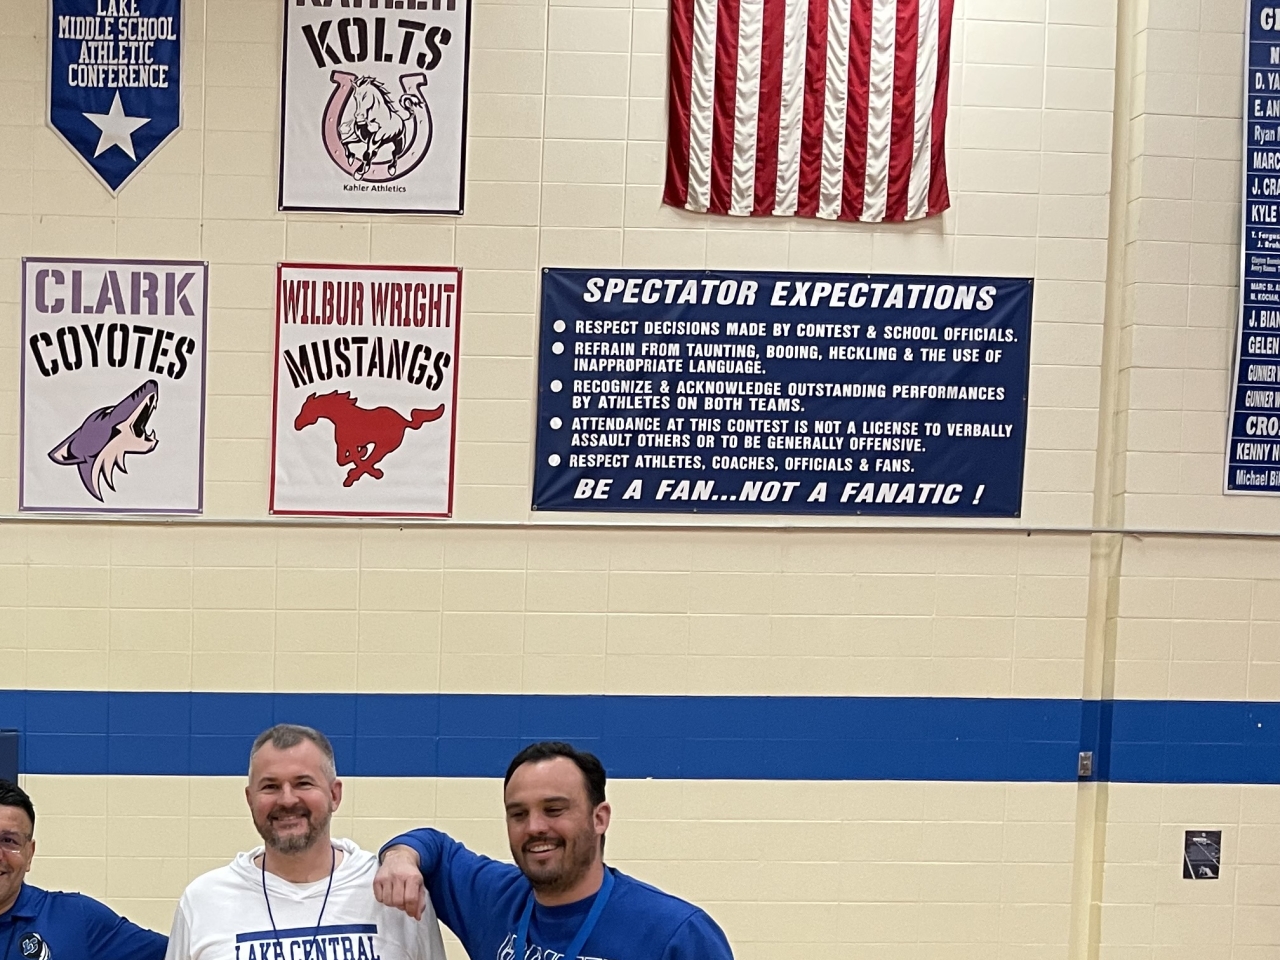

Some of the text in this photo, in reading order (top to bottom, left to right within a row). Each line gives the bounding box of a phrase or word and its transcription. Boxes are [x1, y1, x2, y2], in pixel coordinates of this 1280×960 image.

[97, 0, 140, 16] LAKE
[58, 15, 177, 40] MIDDLE SCHOOL
[78, 41, 154, 64] ATHLETIC
[301, 17, 452, 71] KOLTS
[68, 64, 169, 88] CONFERENCE
[1255, 72, 1266, 90] D.
[1254, 99, 1264, 117] E.
[1254, 125, 1276, 145] Ryan
[343, 184, 407, 193] Kahler Athletics
[1252, 178, 1261, 195] J.
[1251, 205, 1277, 222] KYLE
[34, 269, 196, 318] CLARK
[584, 278, 996, 310] SPECTATOR EXPECTATIONS
[282, 279, 455, 329] WILBUR WRIGHT
[1249, 310, 1258, 328] J.
[576, 320, 1017, 342] RESPECT DECISIONS MADE BY CONTEST & SCHOOL OFFICIALS.
[29, 323, 197, 382] COYOTES
[575, 342, 1002, 362] REFRAIN FROM TAUNTING, BOOING, HECKLING & THE USE OF
[1248, 336, 1279, 354] GELEN
[283, 337, 452, 393] MUSTANGS
[574, 358, 765, 374] INAPPROPRIATE LANGUAGE.
[1248, 364, 1276, 382] GUNNER
[574, 380, 1004, 400] RECOGNIZE & ACKNOWLEDGE OUTSTANDING PERFORMANCES
[1245, 390, 1274, 408] GUNNER
[573, 396, 804, 411] BY ATHLETES ON BOTH TEAMS.
[572, 417, 1012, 437] ATTENDANCE AT THIS CONTEST IS NOT A LICENSE TO VERBALLY
[1246, 415, 1280, 436] CRO
[571, 433, 925, 451] ASSAULT OTHERS OR TO BE GENERALLY OFFENSIVE.
[1236, 443, 1271, 461] KENNY
[570, 454, 914, 472] RESPECT ATHLETES, COACHES, OFFICIALS & FANS.
[1236, 470, 1268, 486] Michael
[574, 479, 613, 499] BE
[622, 480, 642, 499] A
[807, 482, 827, 502] A
[840, 483, 962, 504] FANATIC
[973, 485, 985, 504] !
